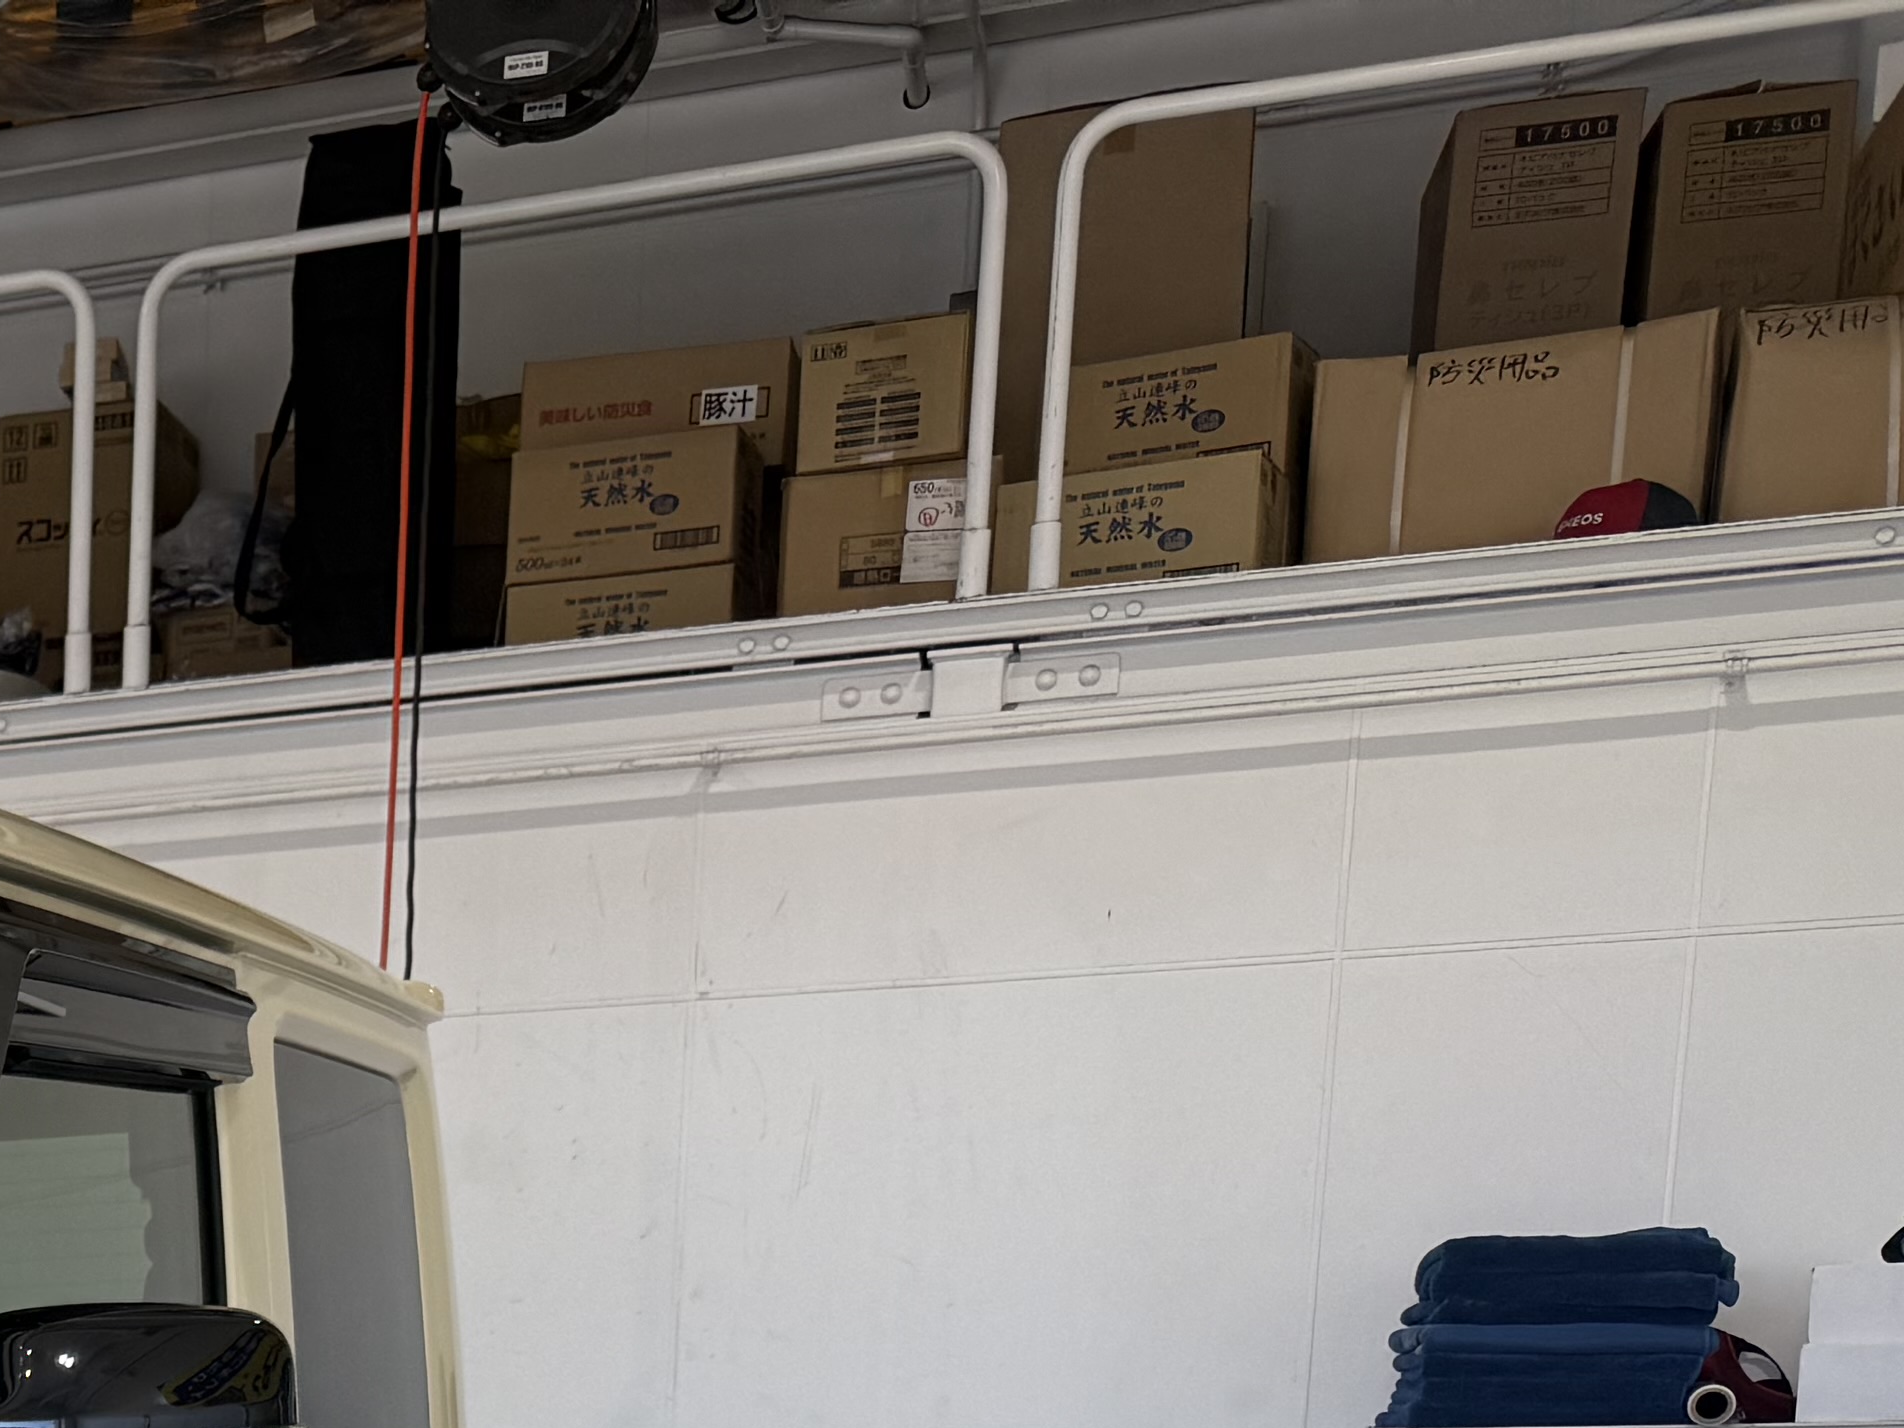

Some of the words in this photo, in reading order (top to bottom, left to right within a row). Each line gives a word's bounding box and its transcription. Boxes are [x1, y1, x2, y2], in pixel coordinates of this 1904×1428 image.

[1525, 119, 1608, 143] 17500
[1735, 114, 1822, 137] 17500
[539, 400, 653, 427] 美味しい防災食
[703, 389, 754, 420] 豚汁
[1113, 395, 1198, 430] 天然水
[580, 479, 654, 509] 天然水
[1076, 512, 1165, 546] 天然水
